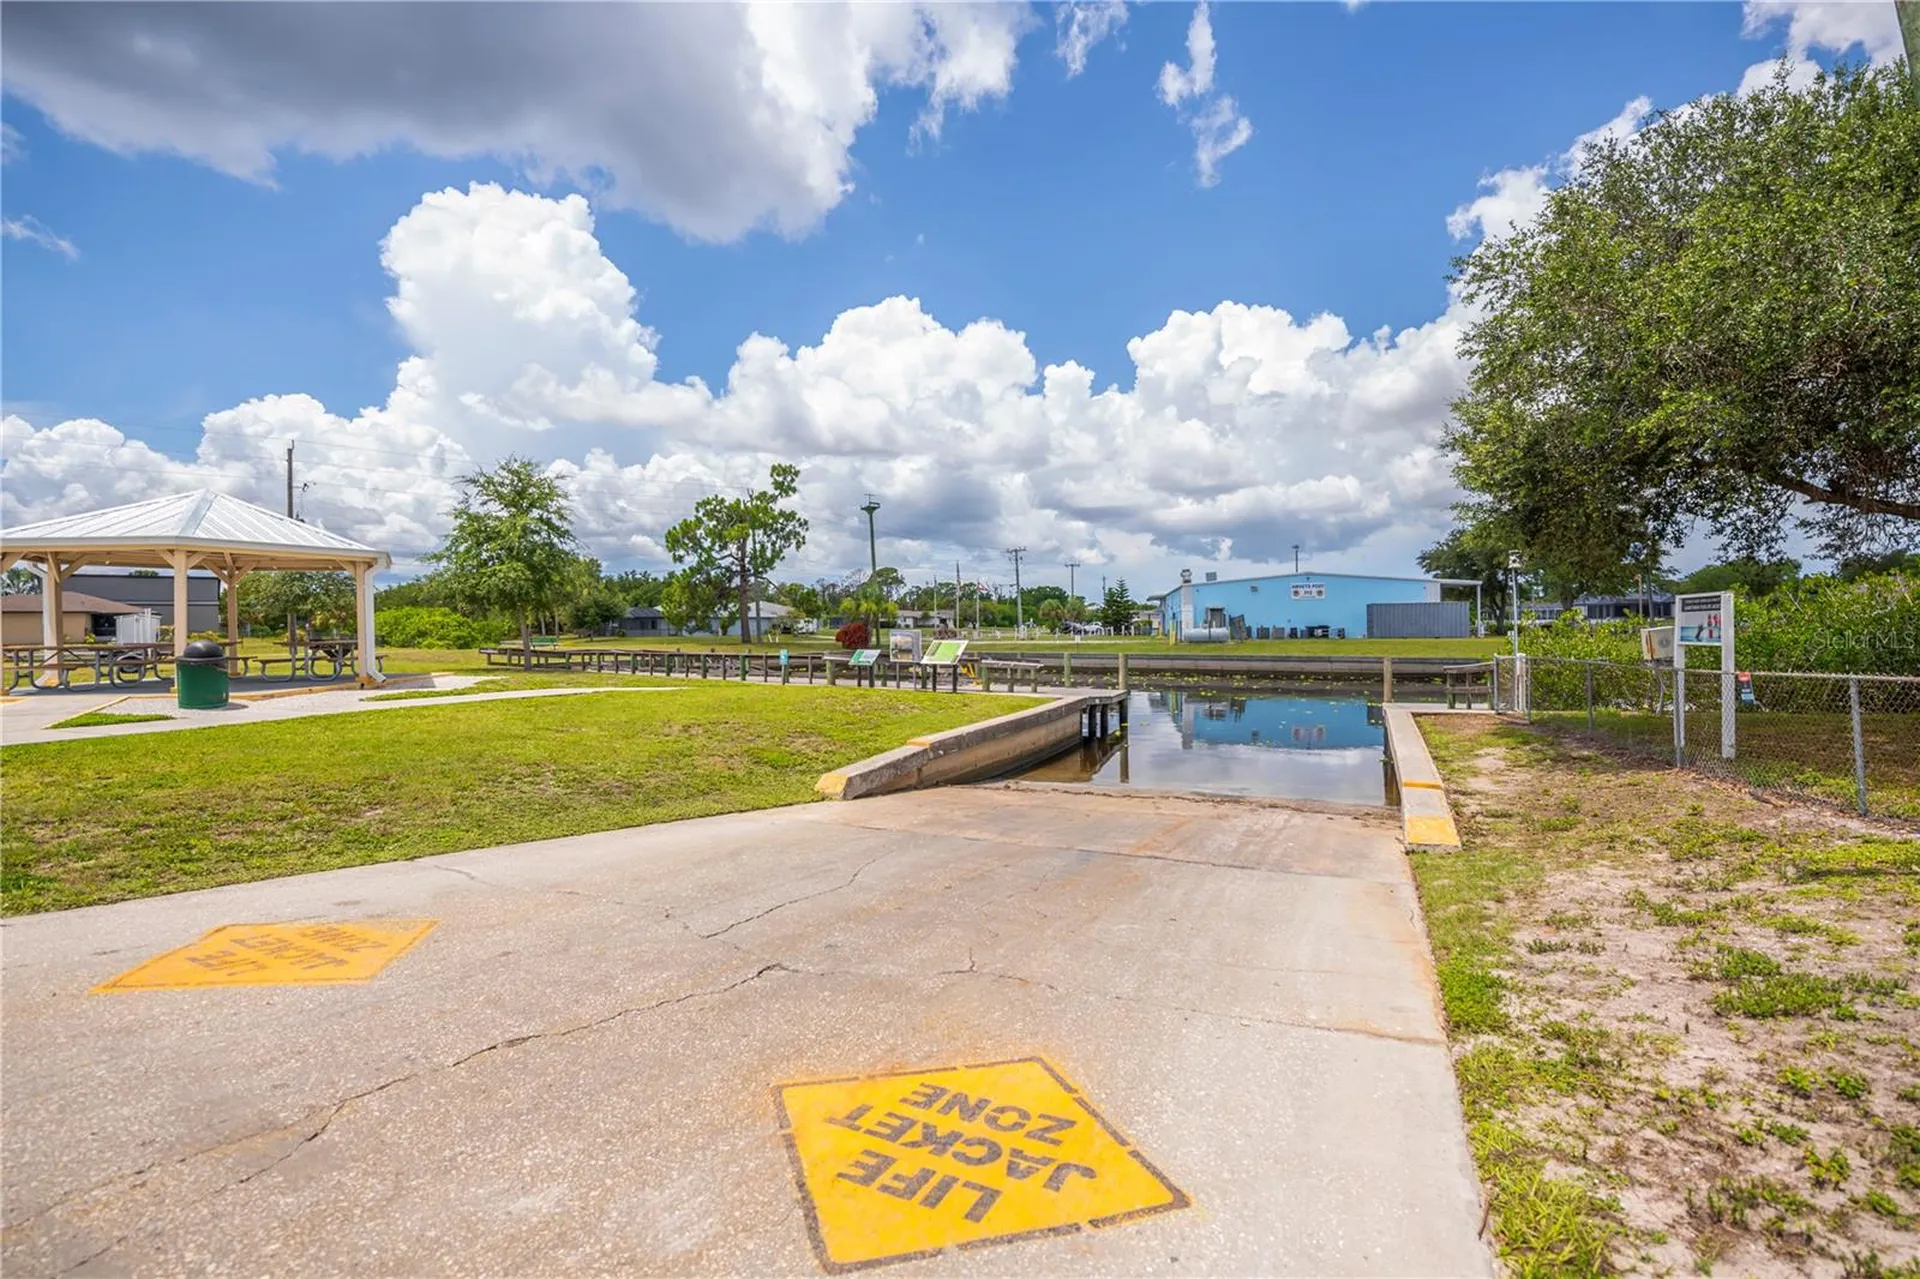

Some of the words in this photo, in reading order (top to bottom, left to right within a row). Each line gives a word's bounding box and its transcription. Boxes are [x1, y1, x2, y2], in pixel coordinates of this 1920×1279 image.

[824, 1103, 1097, 1192] JACKET
[899, 1081, 1078, 1146] ZONE
[836, 1148, 1003, 1223] LIFE
